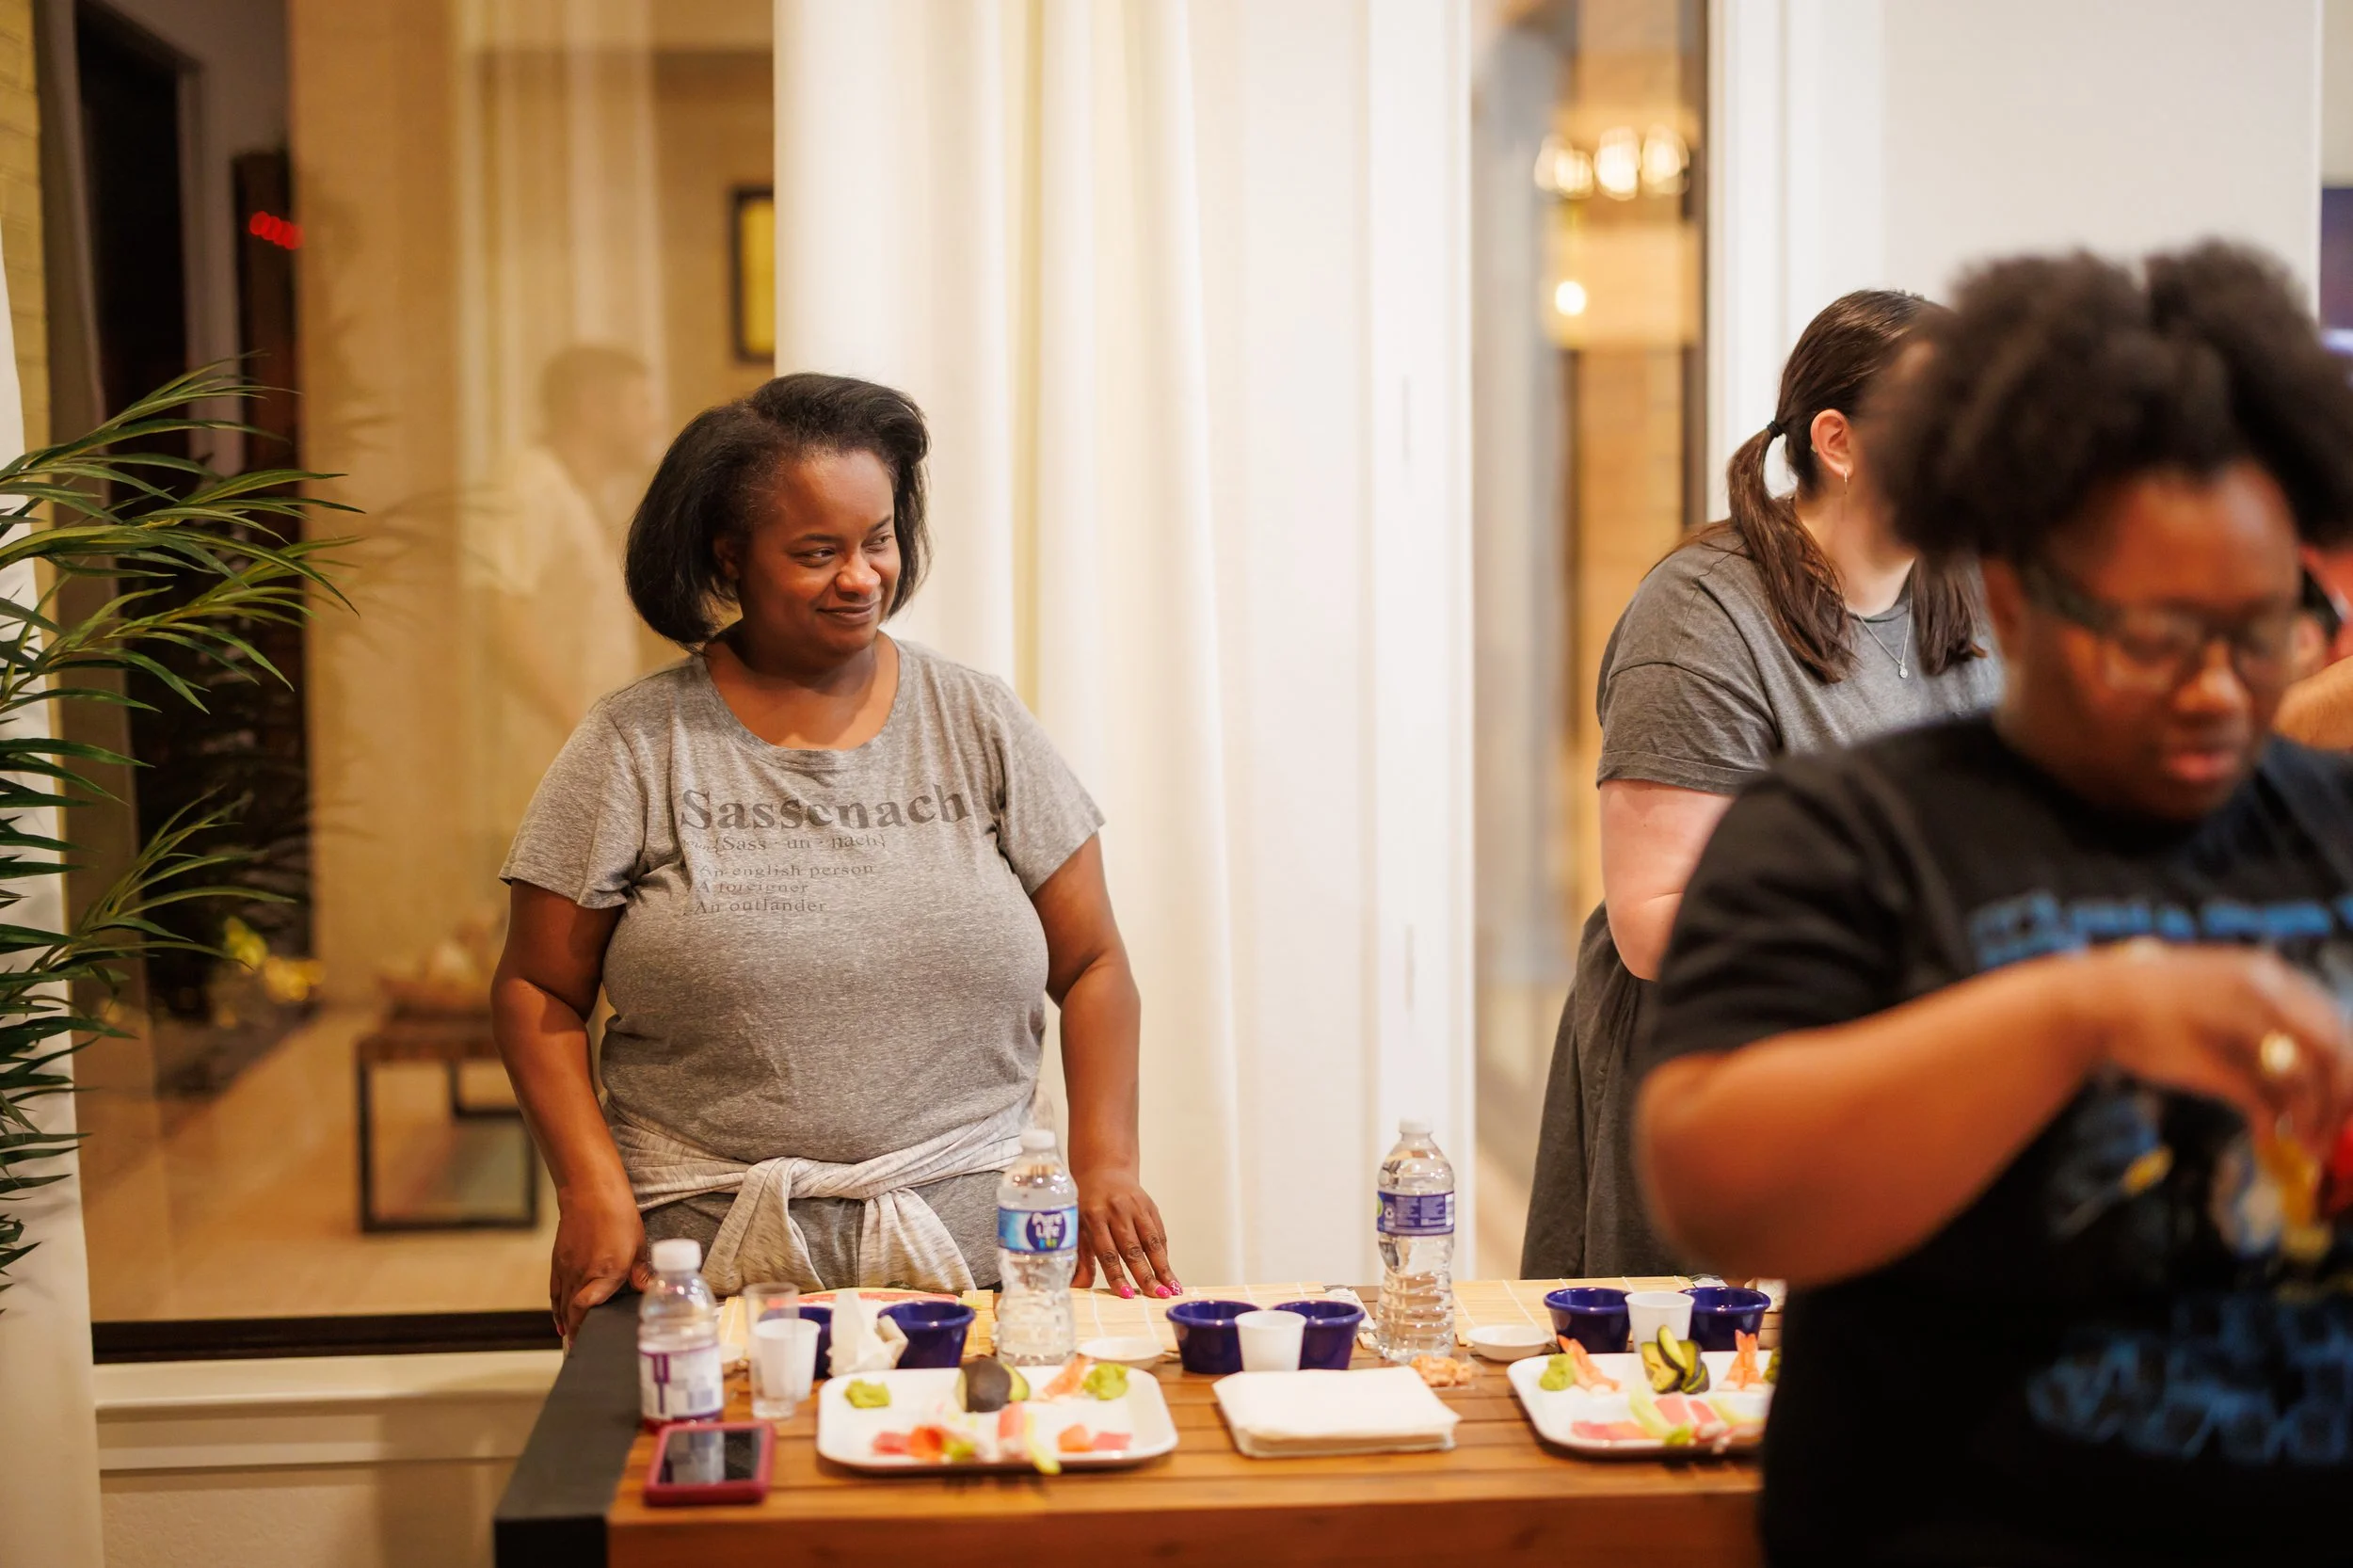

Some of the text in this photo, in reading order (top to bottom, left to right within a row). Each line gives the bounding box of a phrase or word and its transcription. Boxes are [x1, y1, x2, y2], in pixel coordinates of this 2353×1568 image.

[680, 784, 971, 830] Sassenach
[698, 864, 873, 879] An english person
[696, 881, 809, 894] A foreigner
[694, 898, 827, 914] An outlander
